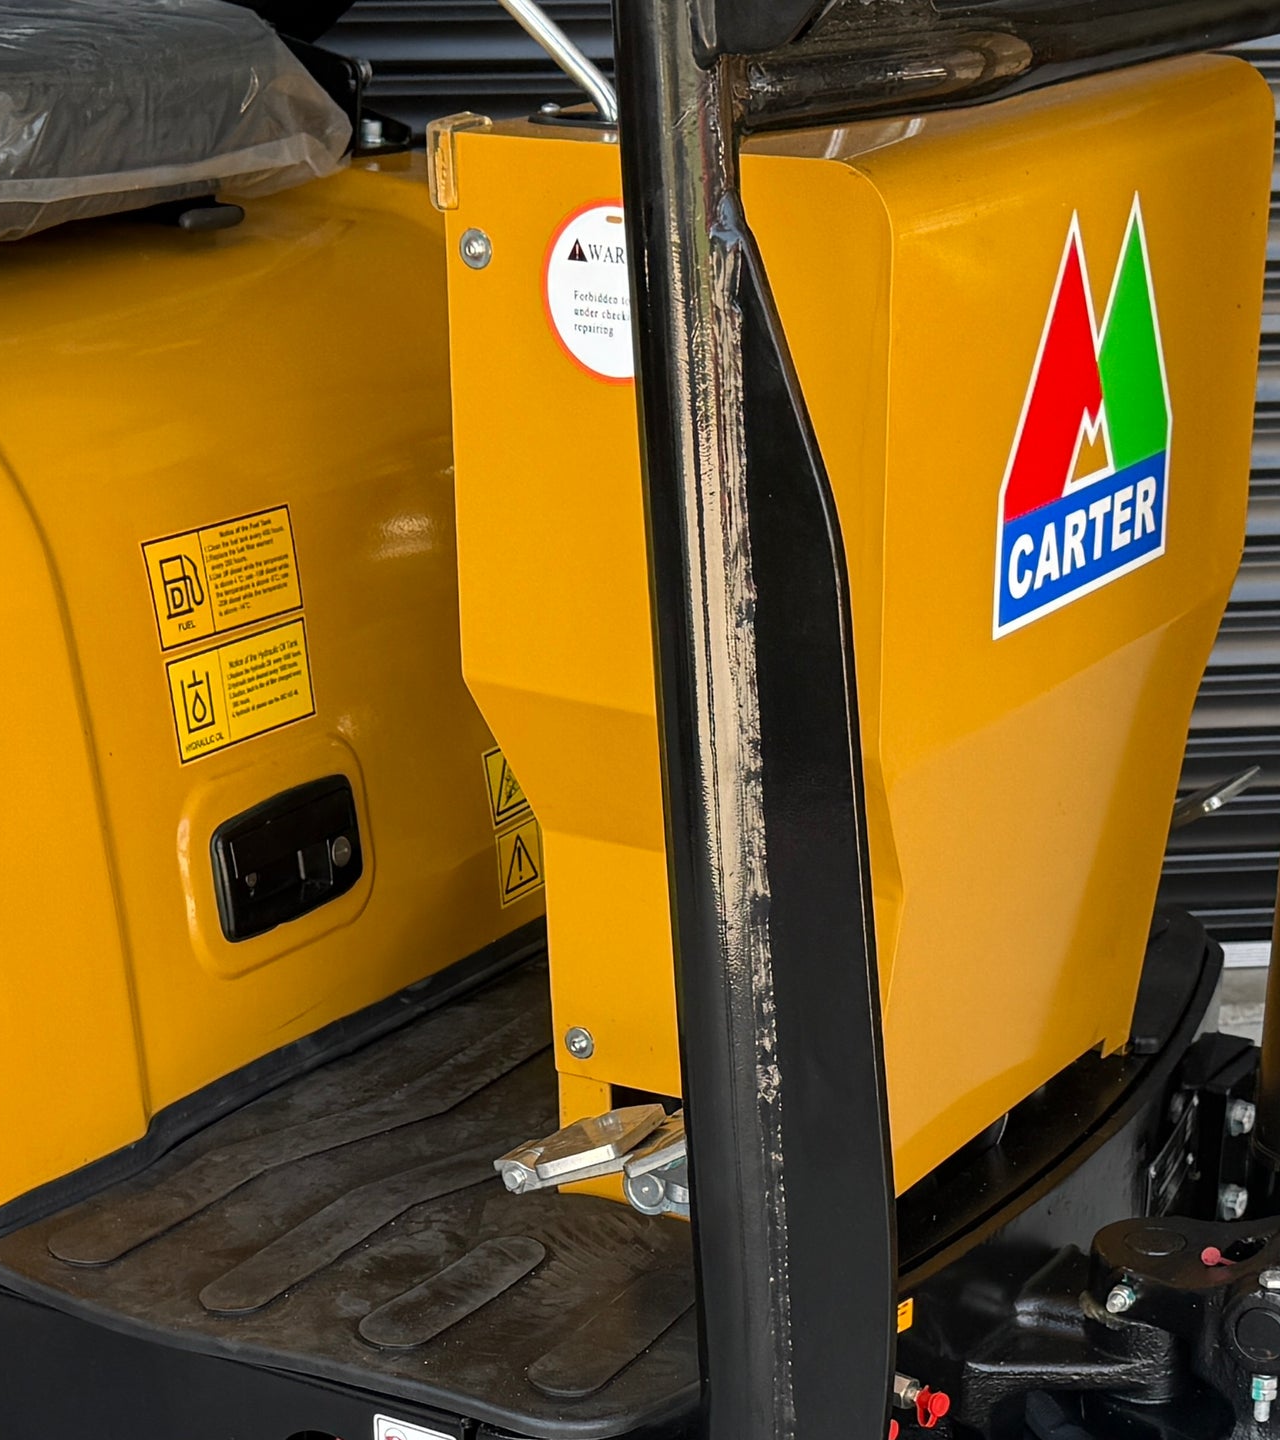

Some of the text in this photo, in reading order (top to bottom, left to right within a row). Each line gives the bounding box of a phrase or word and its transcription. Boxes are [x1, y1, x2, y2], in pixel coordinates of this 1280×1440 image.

[573, 290, 618, 304] Forbidden
[573, 308, 630, 321] under check
[573, 323, 614, 337] repairing
[1008, 475, 1157, 600] CARTER
